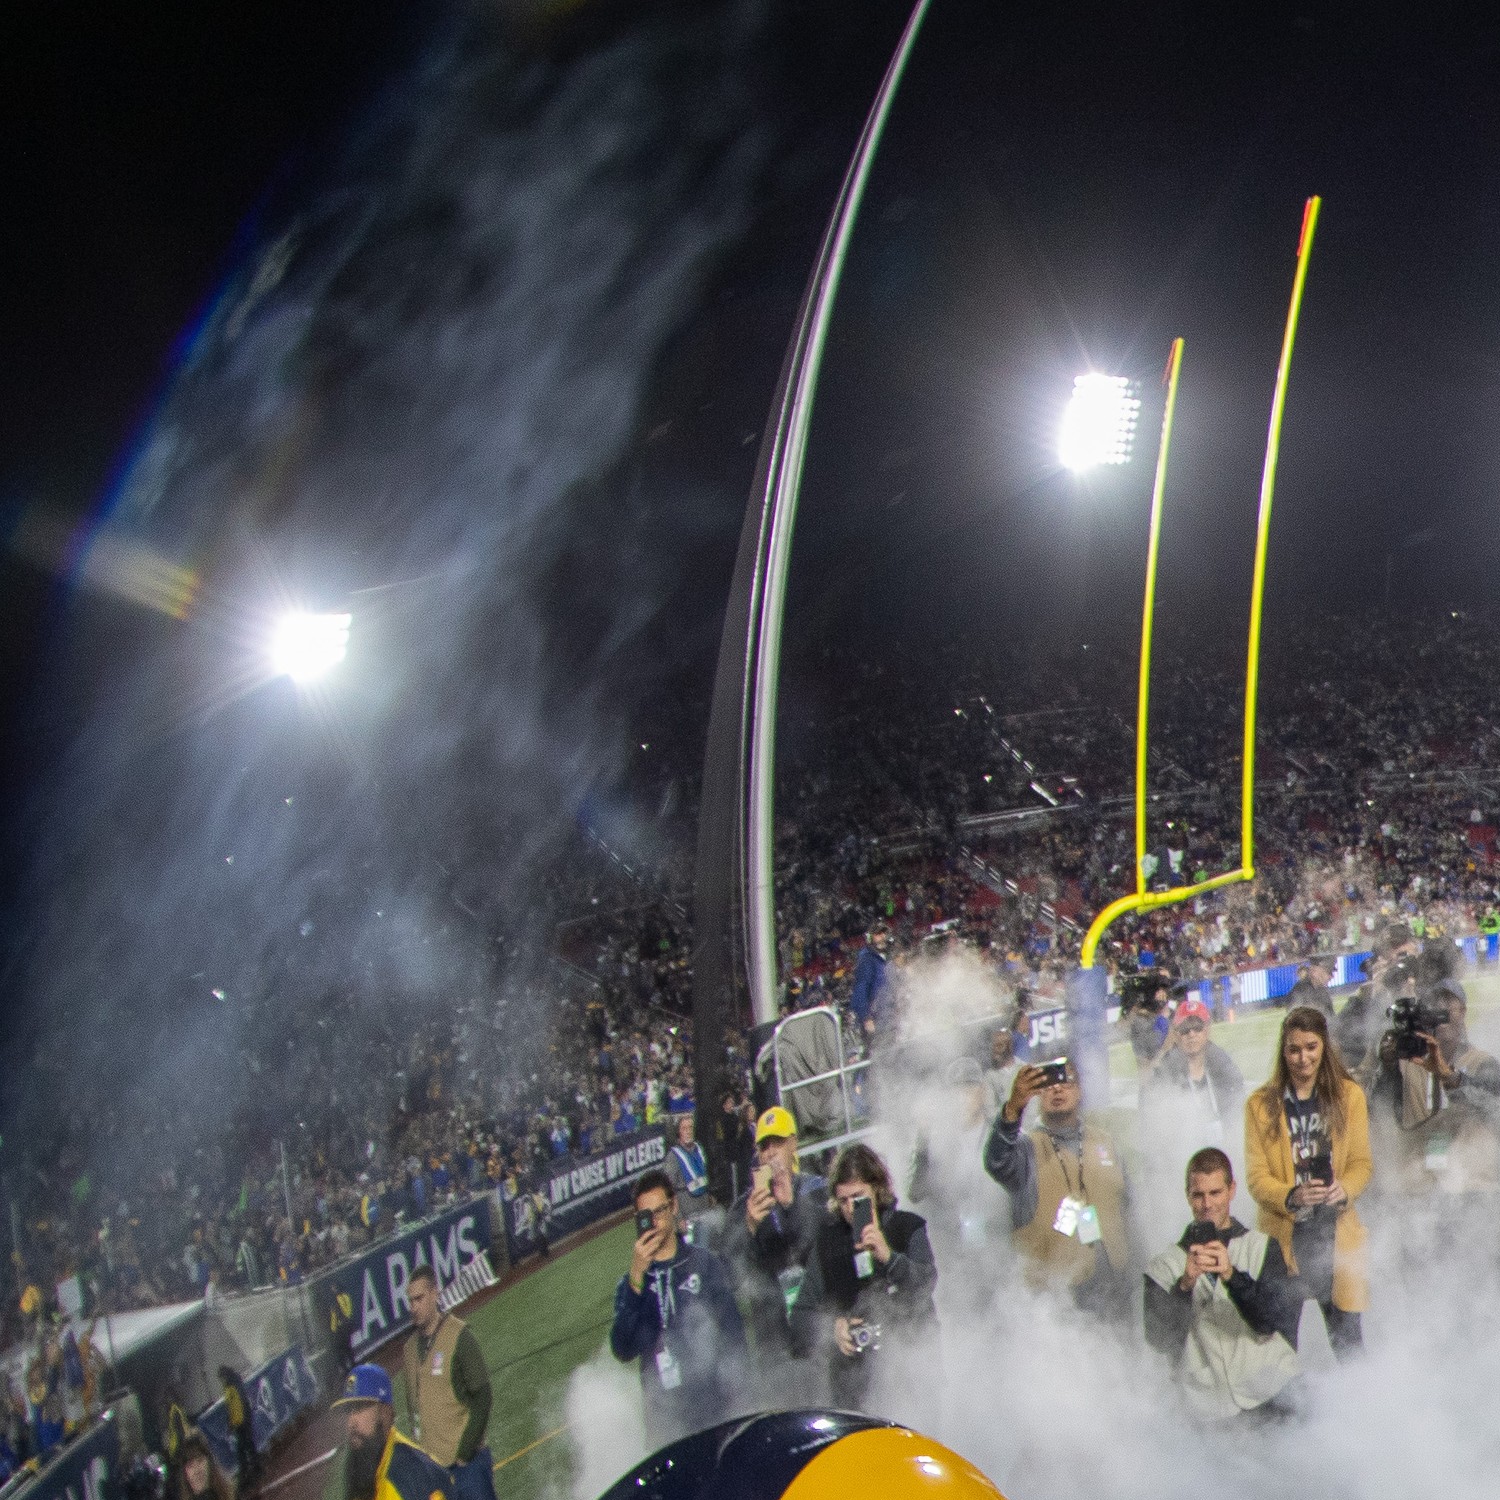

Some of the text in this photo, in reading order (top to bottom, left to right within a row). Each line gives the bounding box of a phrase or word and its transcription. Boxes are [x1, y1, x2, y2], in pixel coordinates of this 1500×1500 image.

[551, 1136, 666, 1206] MY CAUSE MY CLEATS
